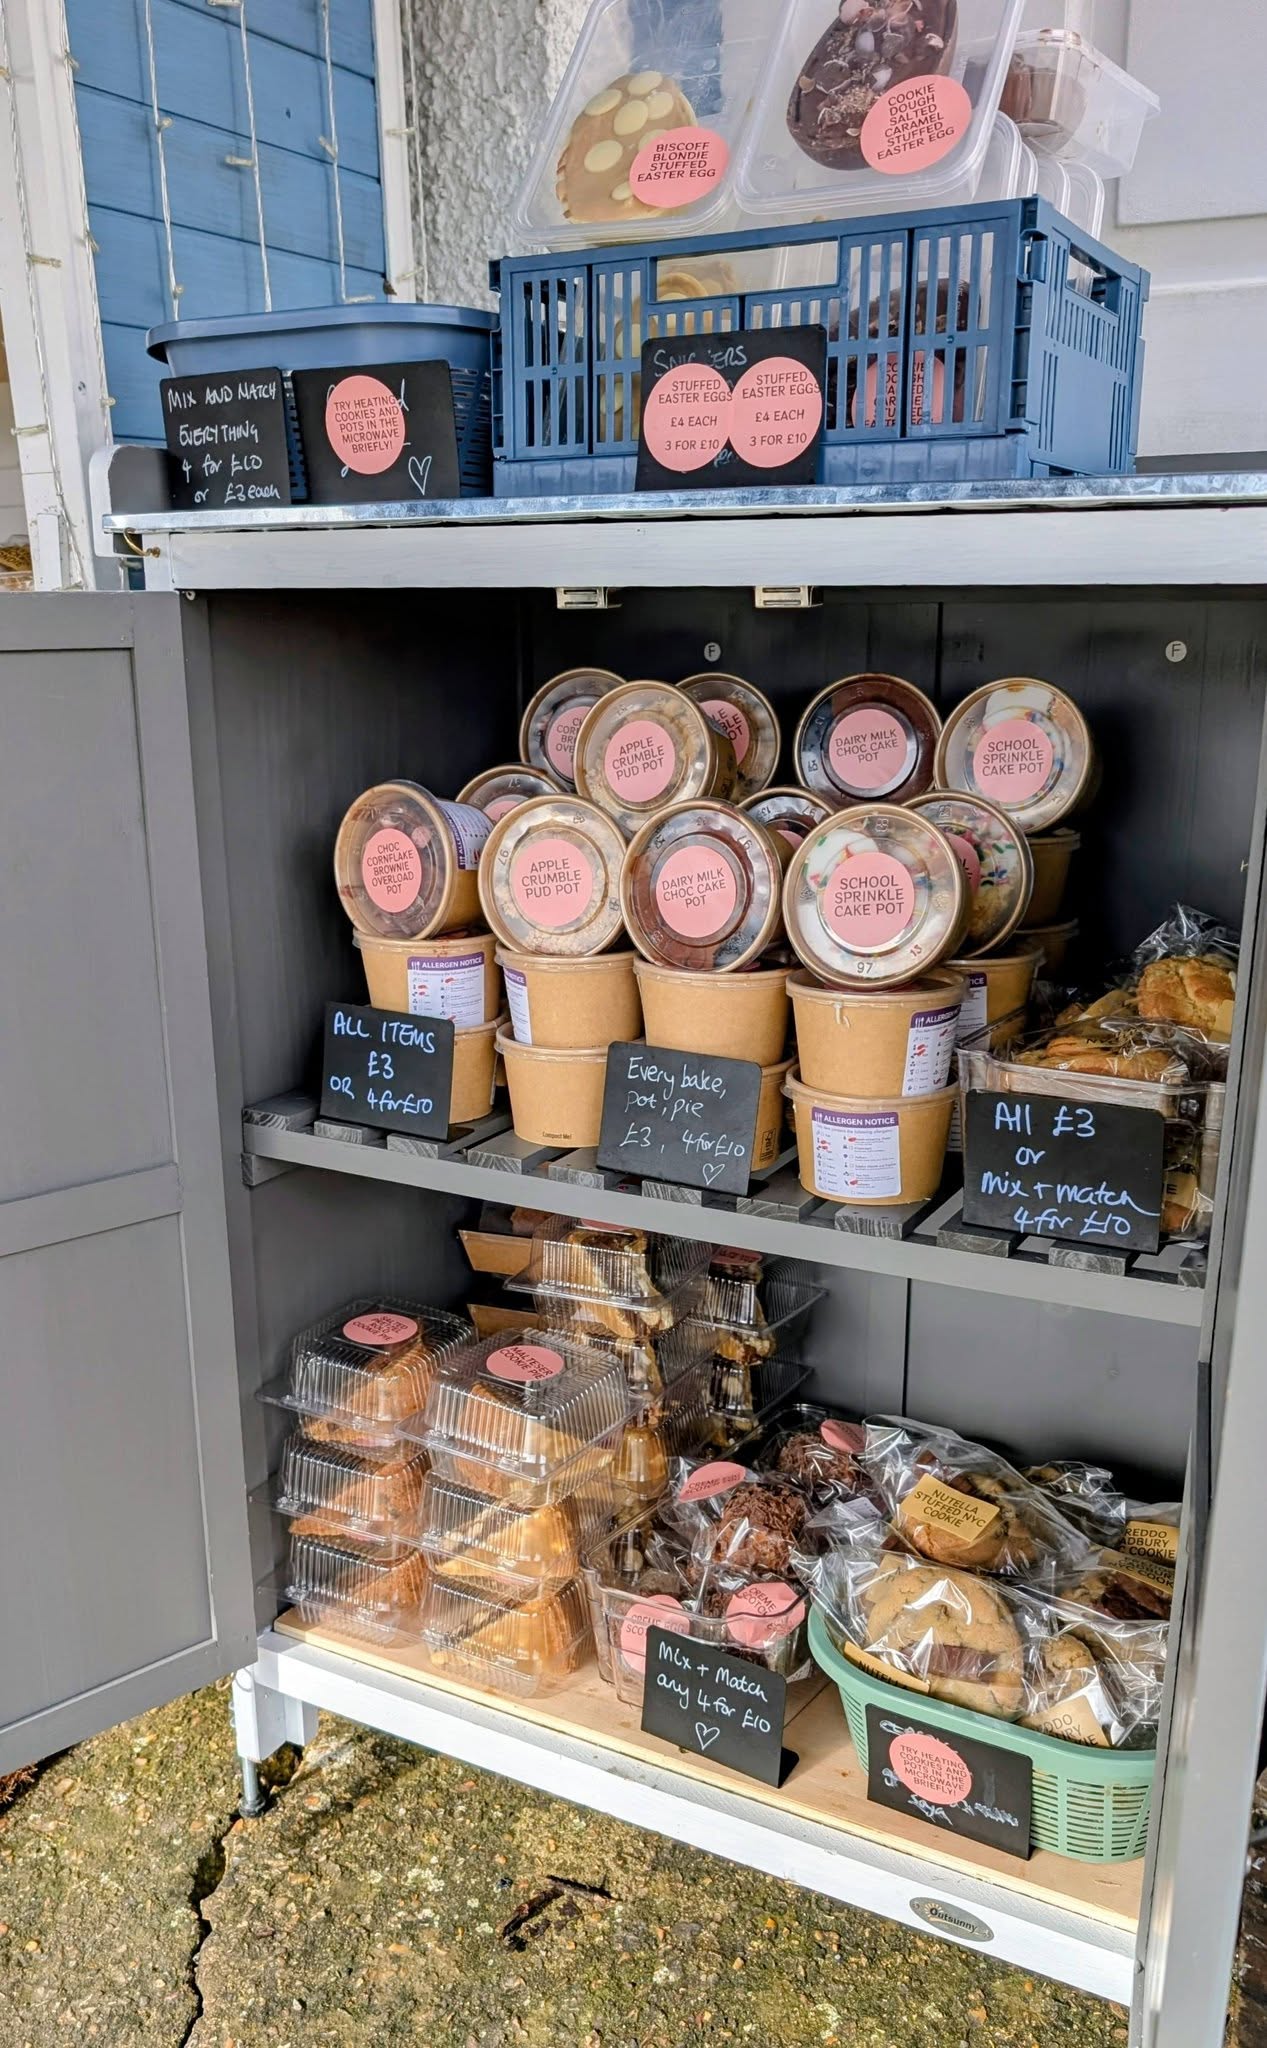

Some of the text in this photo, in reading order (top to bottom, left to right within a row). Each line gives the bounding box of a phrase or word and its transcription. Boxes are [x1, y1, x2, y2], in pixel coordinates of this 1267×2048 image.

[888, 83, 936, 106] COOKIE
[890, 94, 935, 116] DOUGH
[890, 104, 937, 126] SALTED
[884, 112, 944, 138] CARAMEL
[887, 122, 943, 147] STUFFED
[656, 142, 710, 152] BISCOFF
[877, 126, 954, 160] EASTER EGG
[653, 151, 709, 162] BLONDIE
[650, 160, 707, 171] STUFFED
[638, 168, 716, 182] EASTER EGG
[672, 379, 721, 391] STUFFED
[756, 371, 808, 386] STUFFED
[168, 388, 196, 413] MIX
[205, 385, 233, 404] AND
[658, 391, 732, 404] EASTER EGGS
[742, 384, 820, 398] EASTER EGGS
[334, 395, 396, 411] TRY HEATING
[335, 406, 399, 422] COOKIES AND
[670, 416, 718, 428] £4 EACH
[756, 409, 804, 422] £4 EACH
[340, 417, 398, 432] POTS IN THE
[342, 428, 399, 444] MICROWAVE
[750, 433, 807, 446] 3 FOR £10
[352, 441, 392, 454] BRIEFLY!
[665, 439, 719, 450] 3 FOR £10
[182, 454, 262, 483] 4 for £10
[194, 488, 209, 503] or
[708, 644, 716, 658] F
[1172, 644, 1181, 657] F
[620, 736, 654, 756] APPLE
[836, 729, 897, 747] DAIRY MILK
[988, 739, 1039, 752] SCHOOL
[836, 739, 898, 757] CHOC CAKE
[612, 745, 664, 770] CRUMBLE
[858, 752, 879, 763] POT
[983, 750, 1044, 764] SPRINKLE
[616, 757, 664, 780] PUD POT
[982, 762, 1044, 776] CAKE POT
[378, 842, 400, 854] CHOC
[367, 850, 414, 866] CORNFLAKE
[530, 858, 570, 874] APPLE
[374, 862, 409, 876] BROWNIE
[372, 871, 414, 886] OVERLOAD
[522, 870, 582, 887] CRUMBLE
[662, 868, 725, 890] DAIRY MILK
[840, 875, 898, 890] SCHOOL
[386, 884, 402, 894] POT
[526, 882, 580, 899] PUD POT
[664, 878, 726, 902] CHOC CAKE
[834, 888, 904, 904] SPRINKLE
[685, 895, 706, 908] POT
[834, 902, 904, 918] CAKE POT
[422, 957, 482, 969] ALLERGEN NOTICE
[857, 962, 874, 974] 97
[334, 1011, 435, 1054] ALL ITEMS
[368, 1050, 394, 1079] £3
[627, 1057, 674, 1100] Every
[330, 1076, 354, 1100] OR
[670, 1099, 704, 1121] pie
[824, 1115, 894, 1126] ALLERGEN NOTICE
[995, 1102, 1096, 1137] All £3
[682, 1130, 694, 1154] 4
[694, 1132, 715, 1152] for
[714, 1134, 745, 1156] £10
[1016, 1146, 1046, 1166] or
[1013, 1206, 1130, 1236] 4 for £10
[353, 1322, 380, 1334] COOKIE
[500, 1349, 545, 1380] COOKIE PIE
[511, 1347, 553, 1376] MALTESER
[914, 1491, 986, 1528] STUFFED NYC
[932, 1490, 978, 1514] NUTELLA
[924, 1506, 964, 1528] COOKIE
[1125, 1528, 1168, 1538] REDDO
[1120, 1537, 1170, 1548] ADBURY
[1129, 1546, 1176, 1559] COOKIE
[1138, 1570, 1174, 1589] COOK
[749, 1587, 776, 1612] CREME
[659, 1641, 691, 1670] Mix
[716, 1667, 768, 1702] Match
[656, 1674, 770, 1732] any 4 for £10
[900, 1745, 965, 1770] TRY HEATING
[900, 1752, 967, 1778] COOKIES AND
[904, 1760, 928, 1774] POTS
[945, 1773, 964, 1784] THE
[905, 1767, 964, 1792] MICROWAVE
[914, 1777, 956, 1796] BRIEFLY!
[930, 1907, 978, 1934] Outsunny
